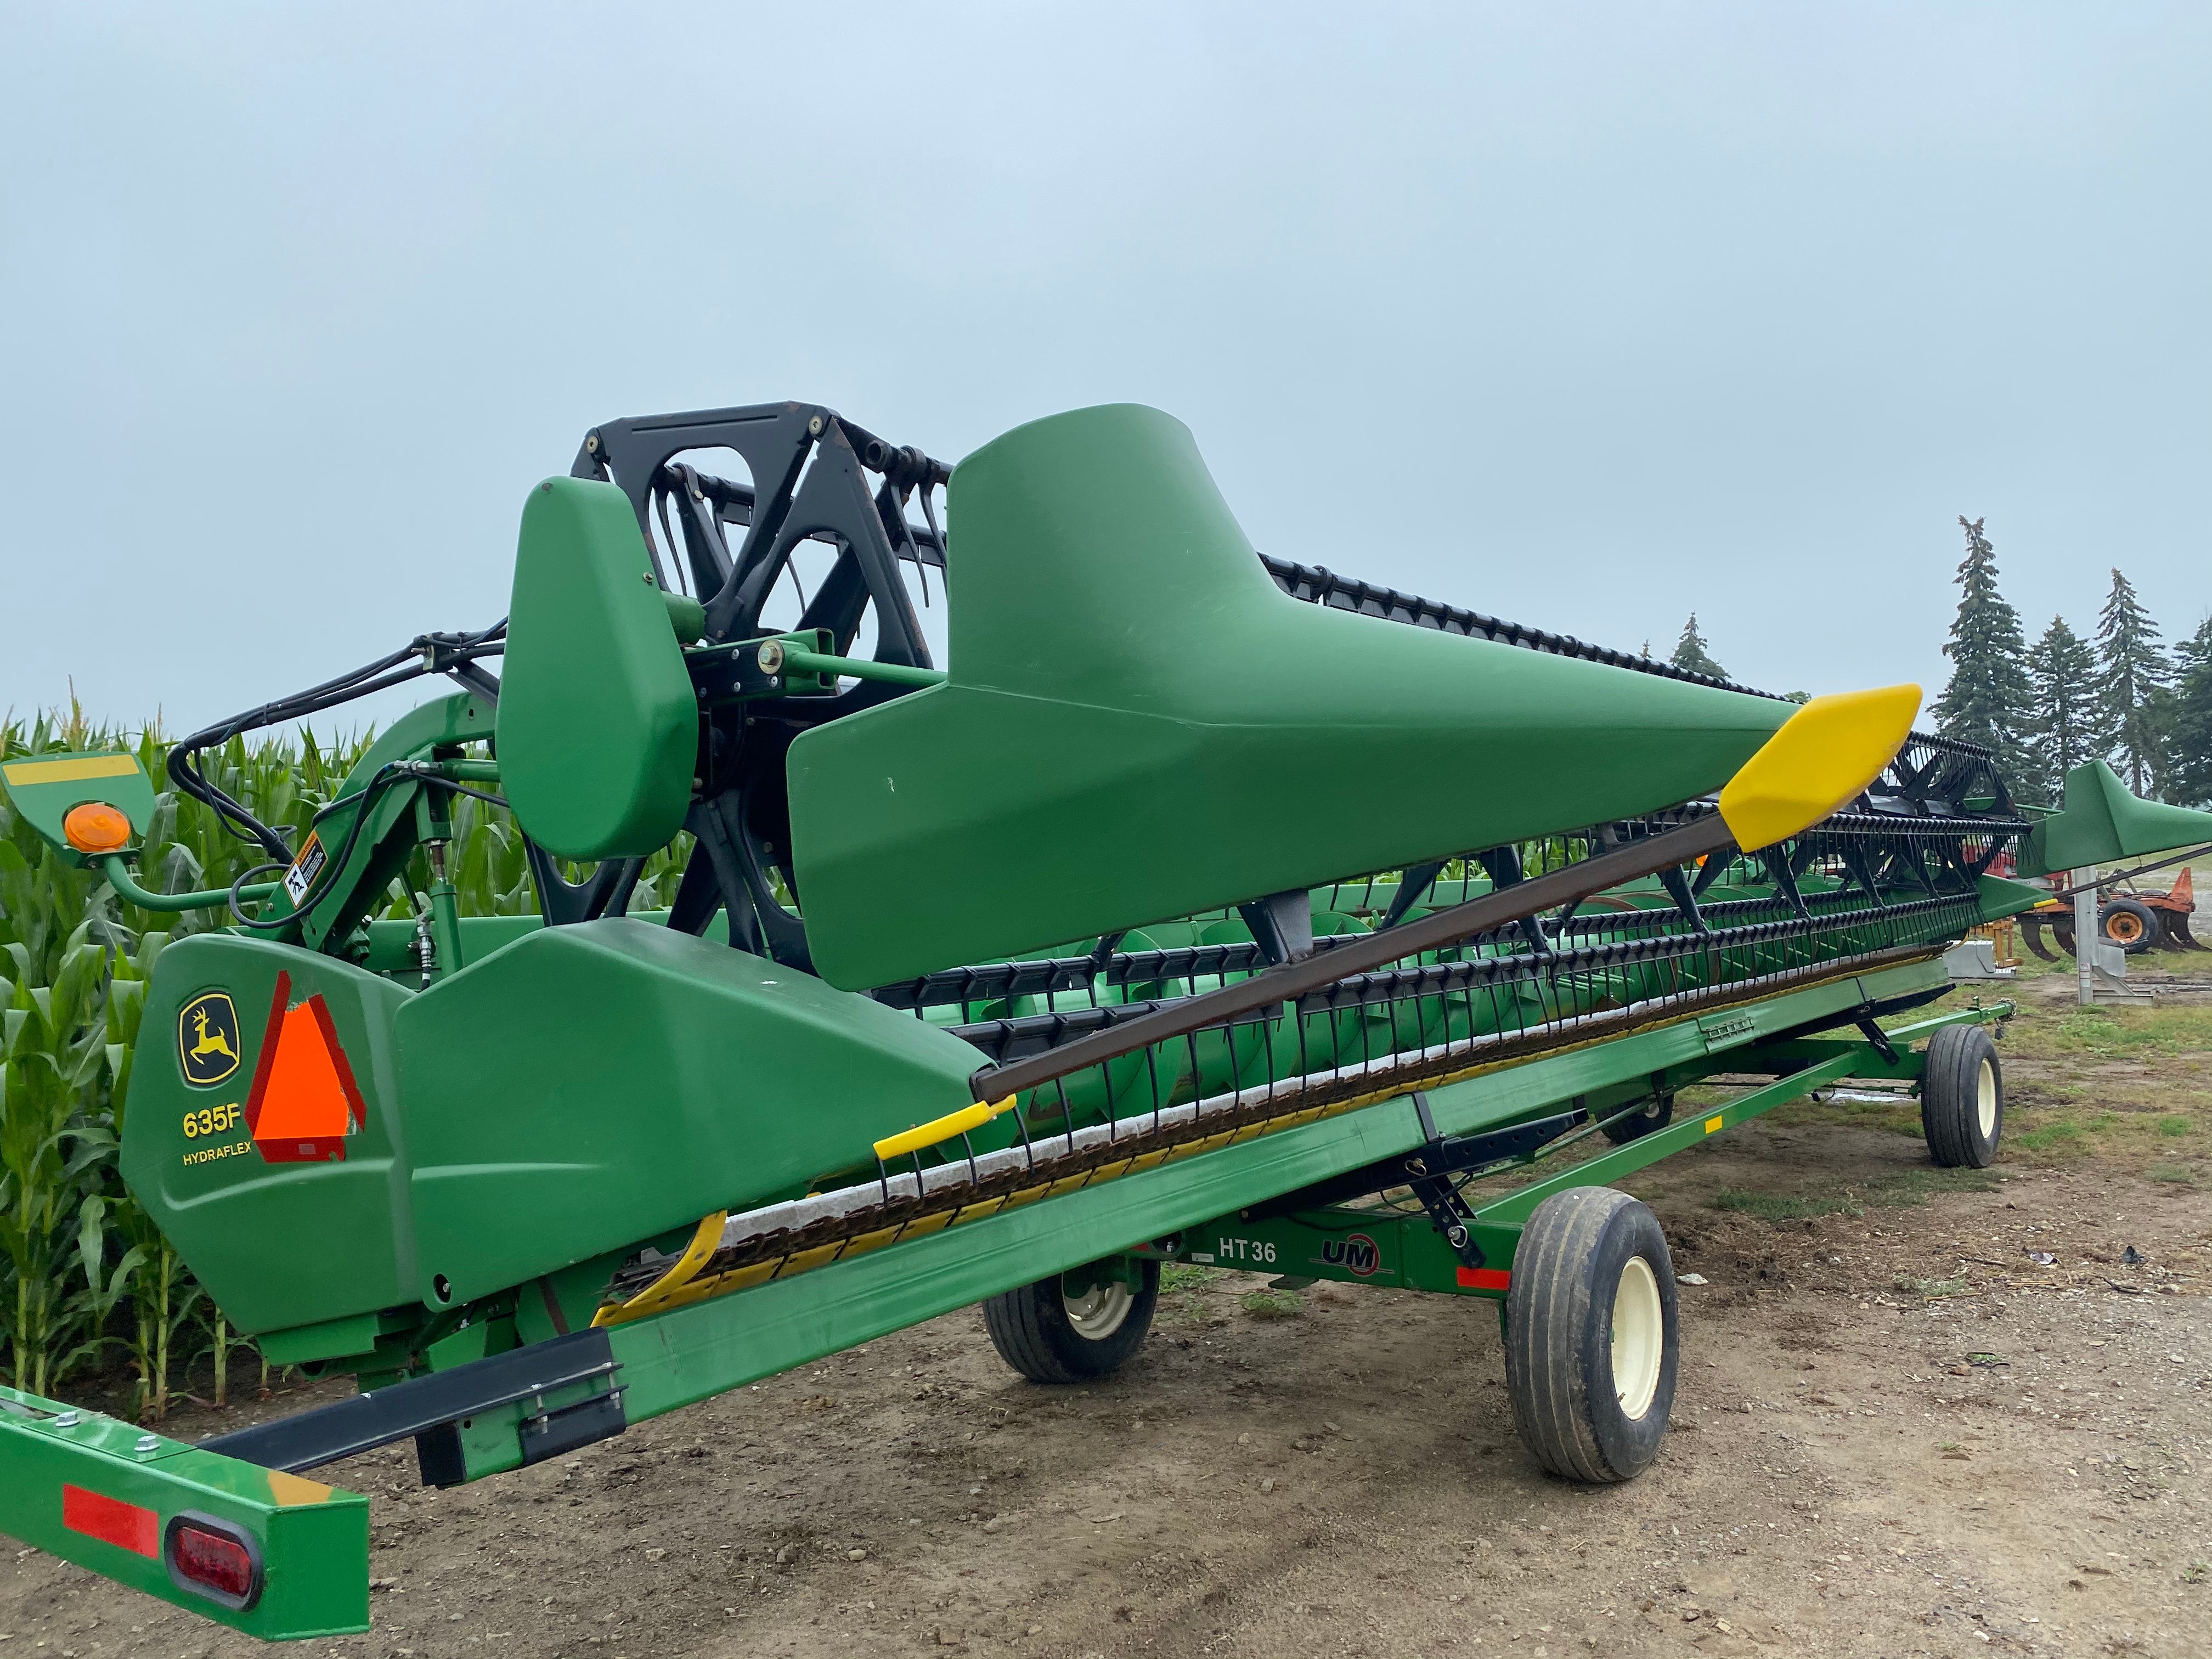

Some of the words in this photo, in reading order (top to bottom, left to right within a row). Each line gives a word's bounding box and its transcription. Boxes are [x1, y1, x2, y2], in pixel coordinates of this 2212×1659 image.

[302, 835, 315, 857] WARNING
[183, 1102, 241, 1137] 635F
[183, 1141, 251, 1166] HYDRAFLEX
[1322, 1239, 1375, 1268] UM
